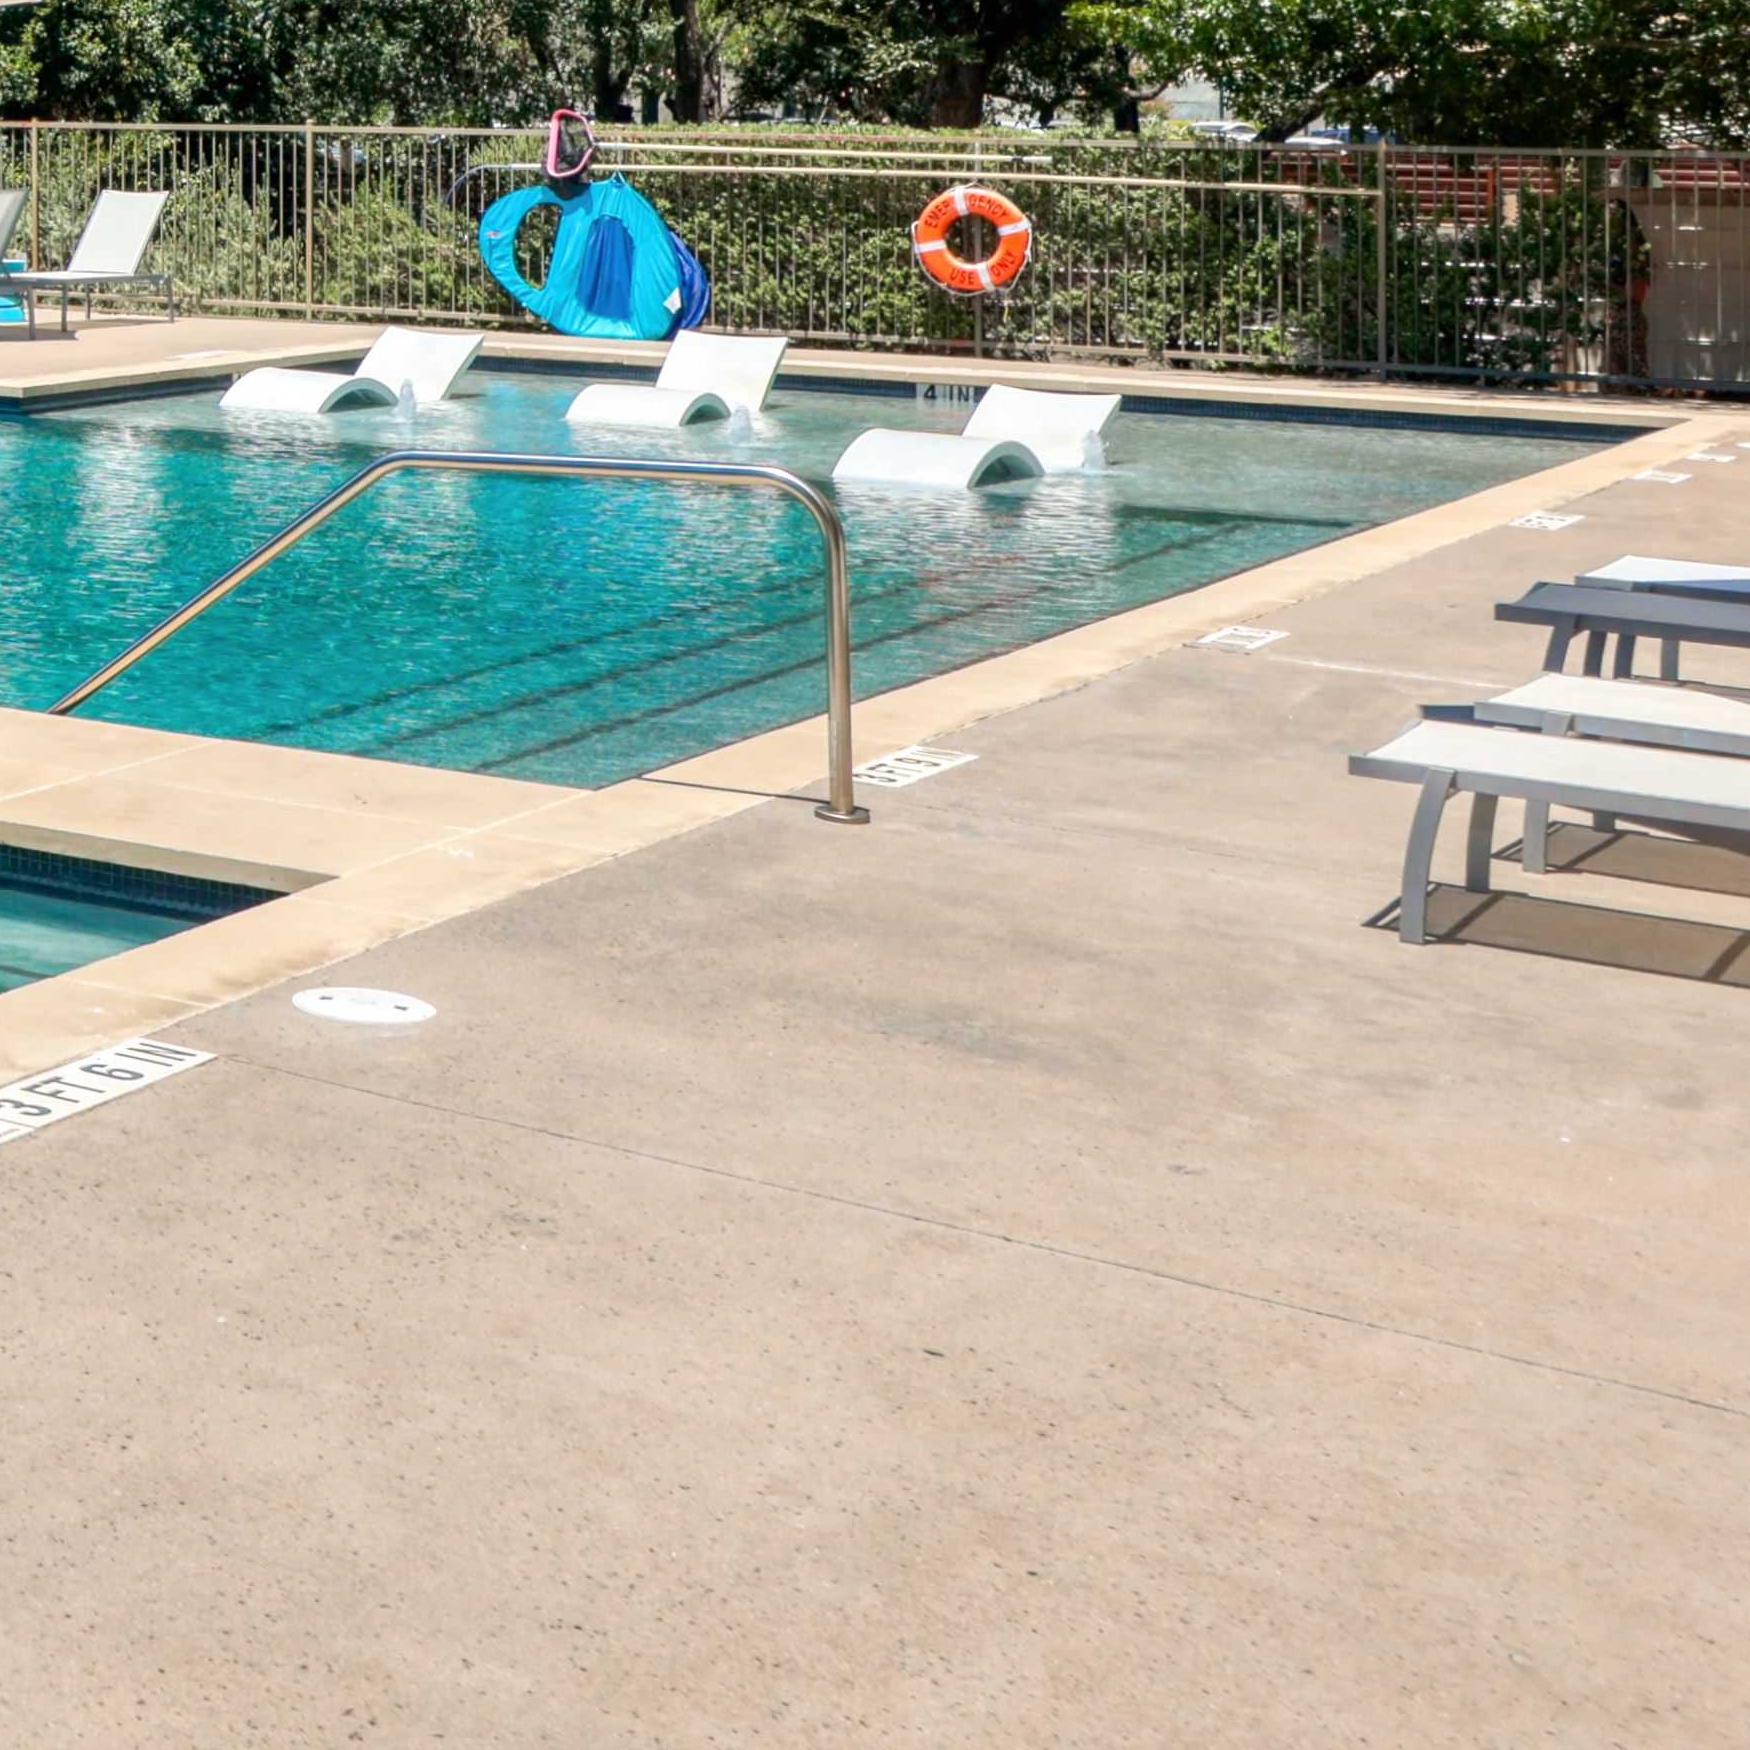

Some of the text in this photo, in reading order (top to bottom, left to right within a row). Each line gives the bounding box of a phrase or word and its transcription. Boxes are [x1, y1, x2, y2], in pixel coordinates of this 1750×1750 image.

[968, 194, 1010, 219] GENCY
[950, 249, 1016, 285] USE ONLY
[19, 1075, 106, 1104] FT
[79, 1062, 145, 1081] 6
[115, 1041, 198, 1067] IN
